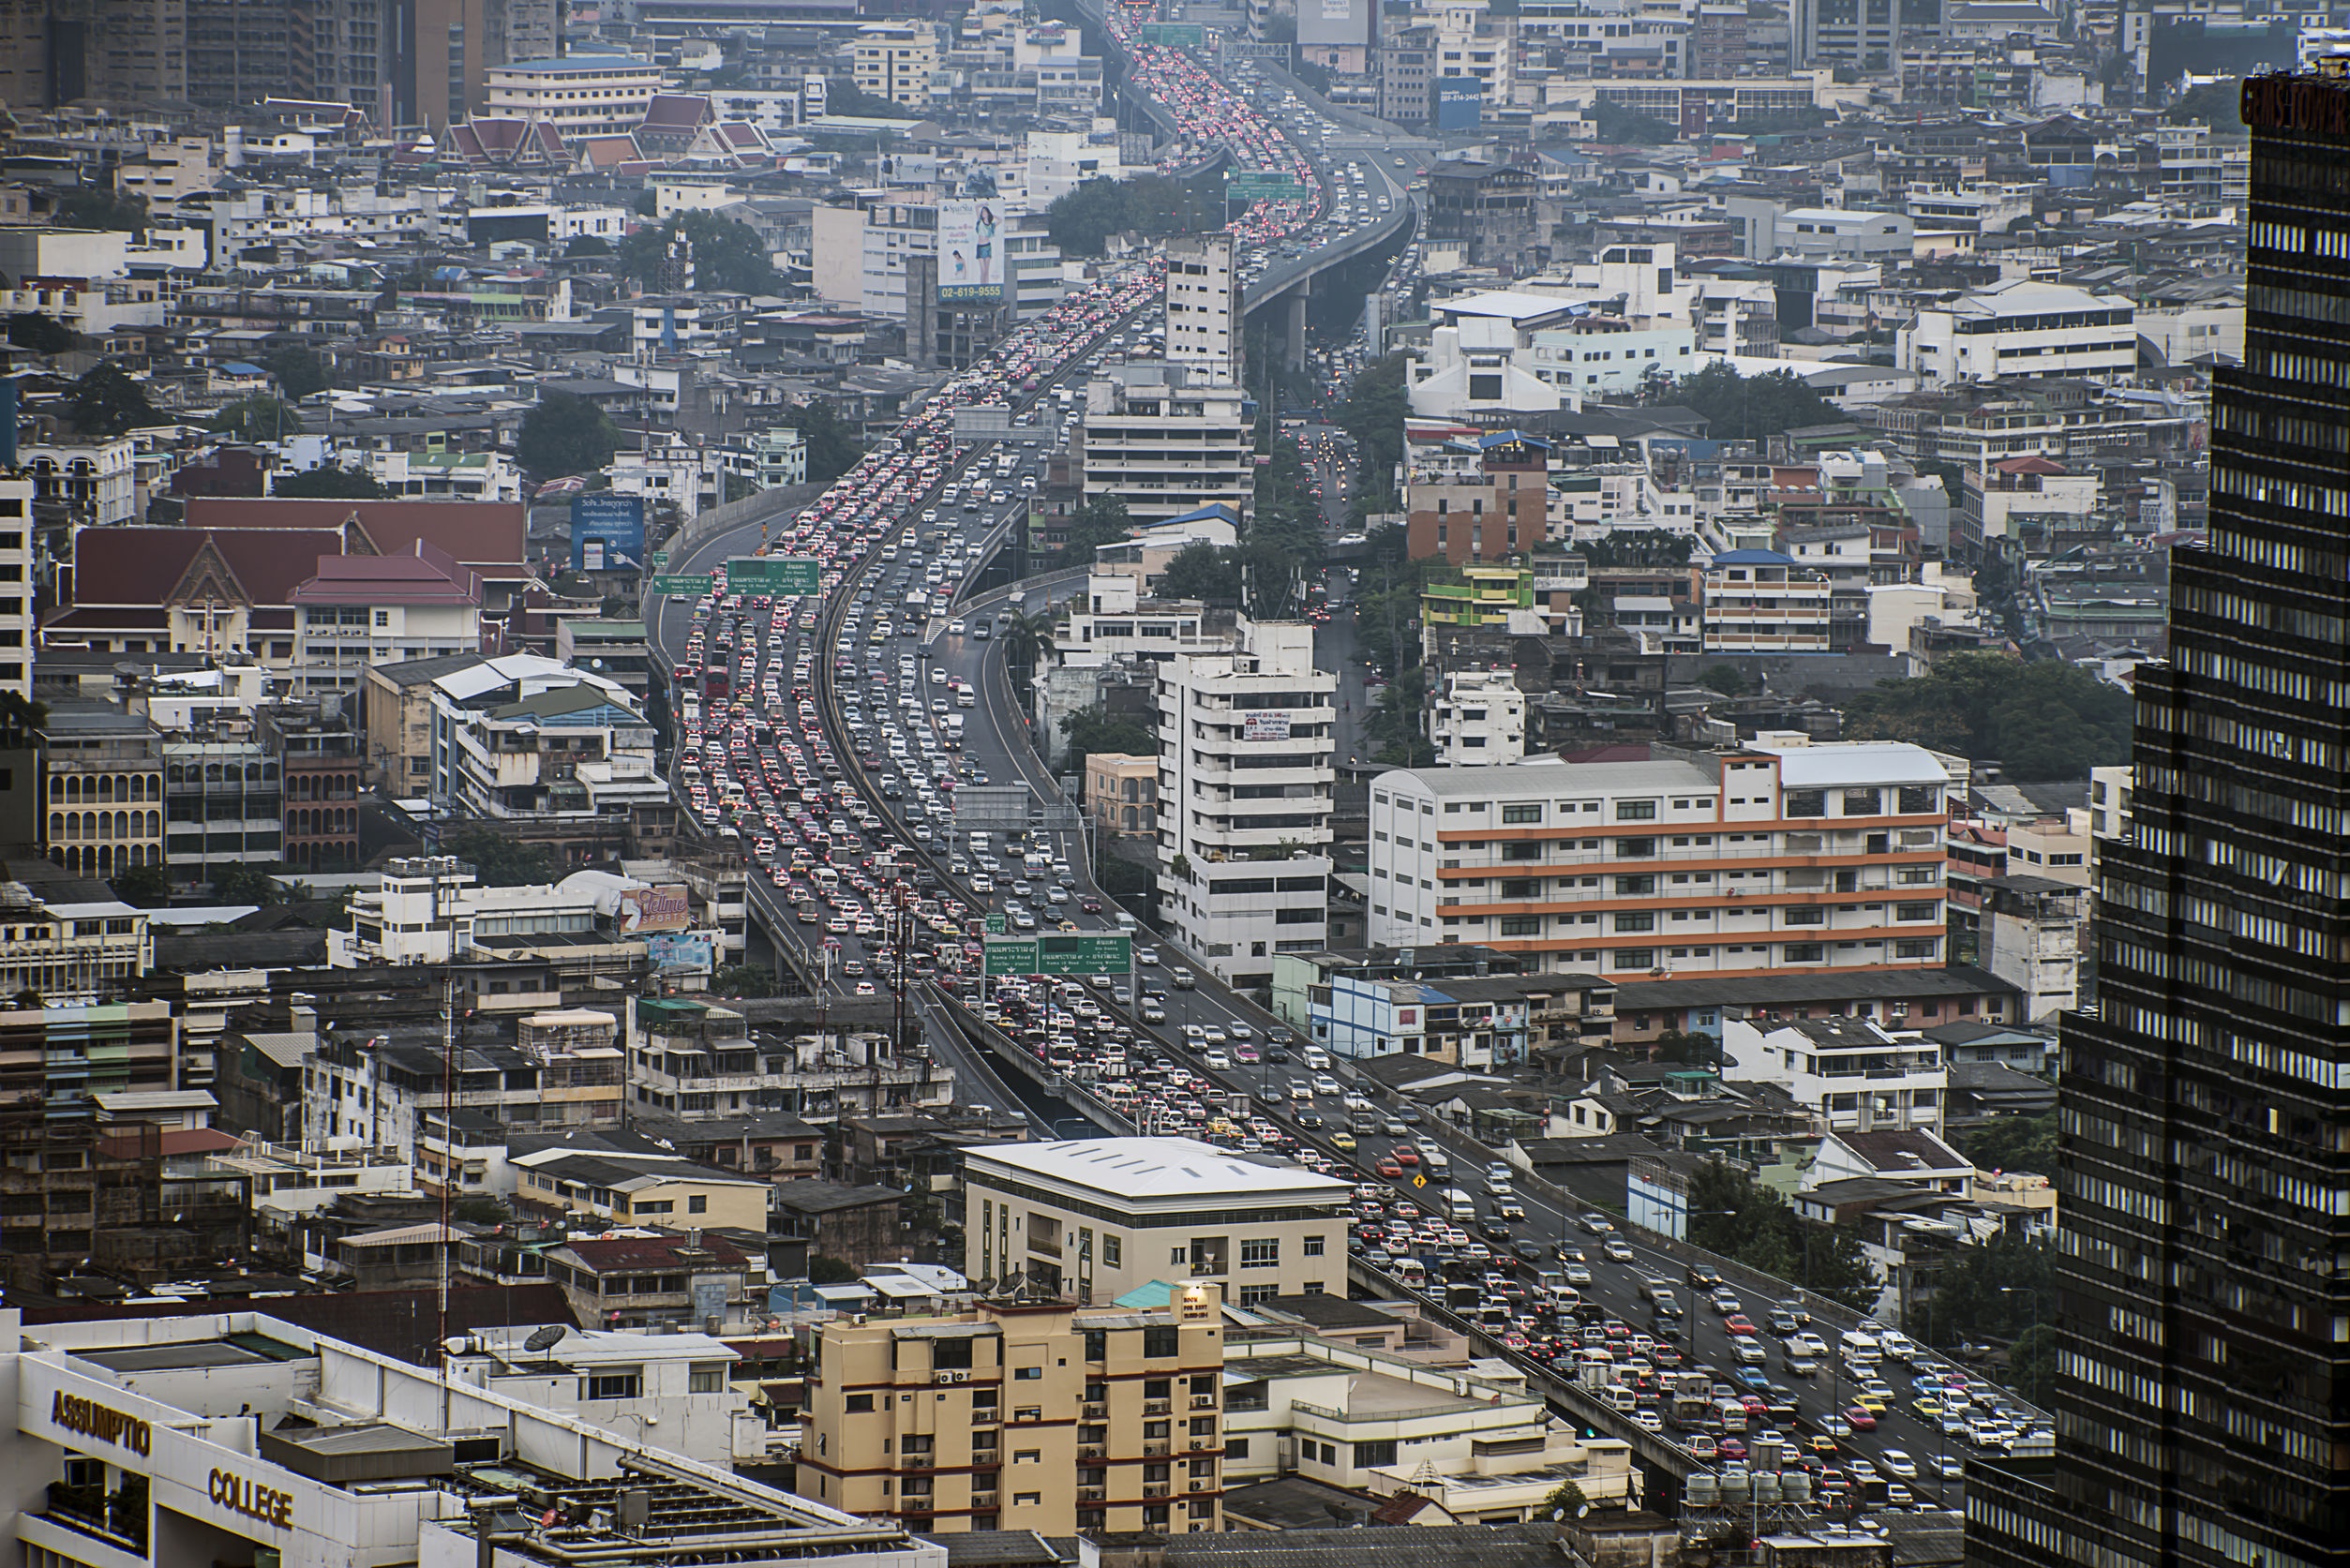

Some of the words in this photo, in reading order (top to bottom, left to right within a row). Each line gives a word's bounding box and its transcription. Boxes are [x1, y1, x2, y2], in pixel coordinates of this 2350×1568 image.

[2240, 78, 2284, 128] GEMS
[2290, 82, 2348, 135] TOWER
[942, 286, 1001, 298] 02-619-9555
[639, 890, 686, 914] Tellme
[643, 913, 686, 924] SPORTS
[208, 1466, 295, 1531] COLLEGE
